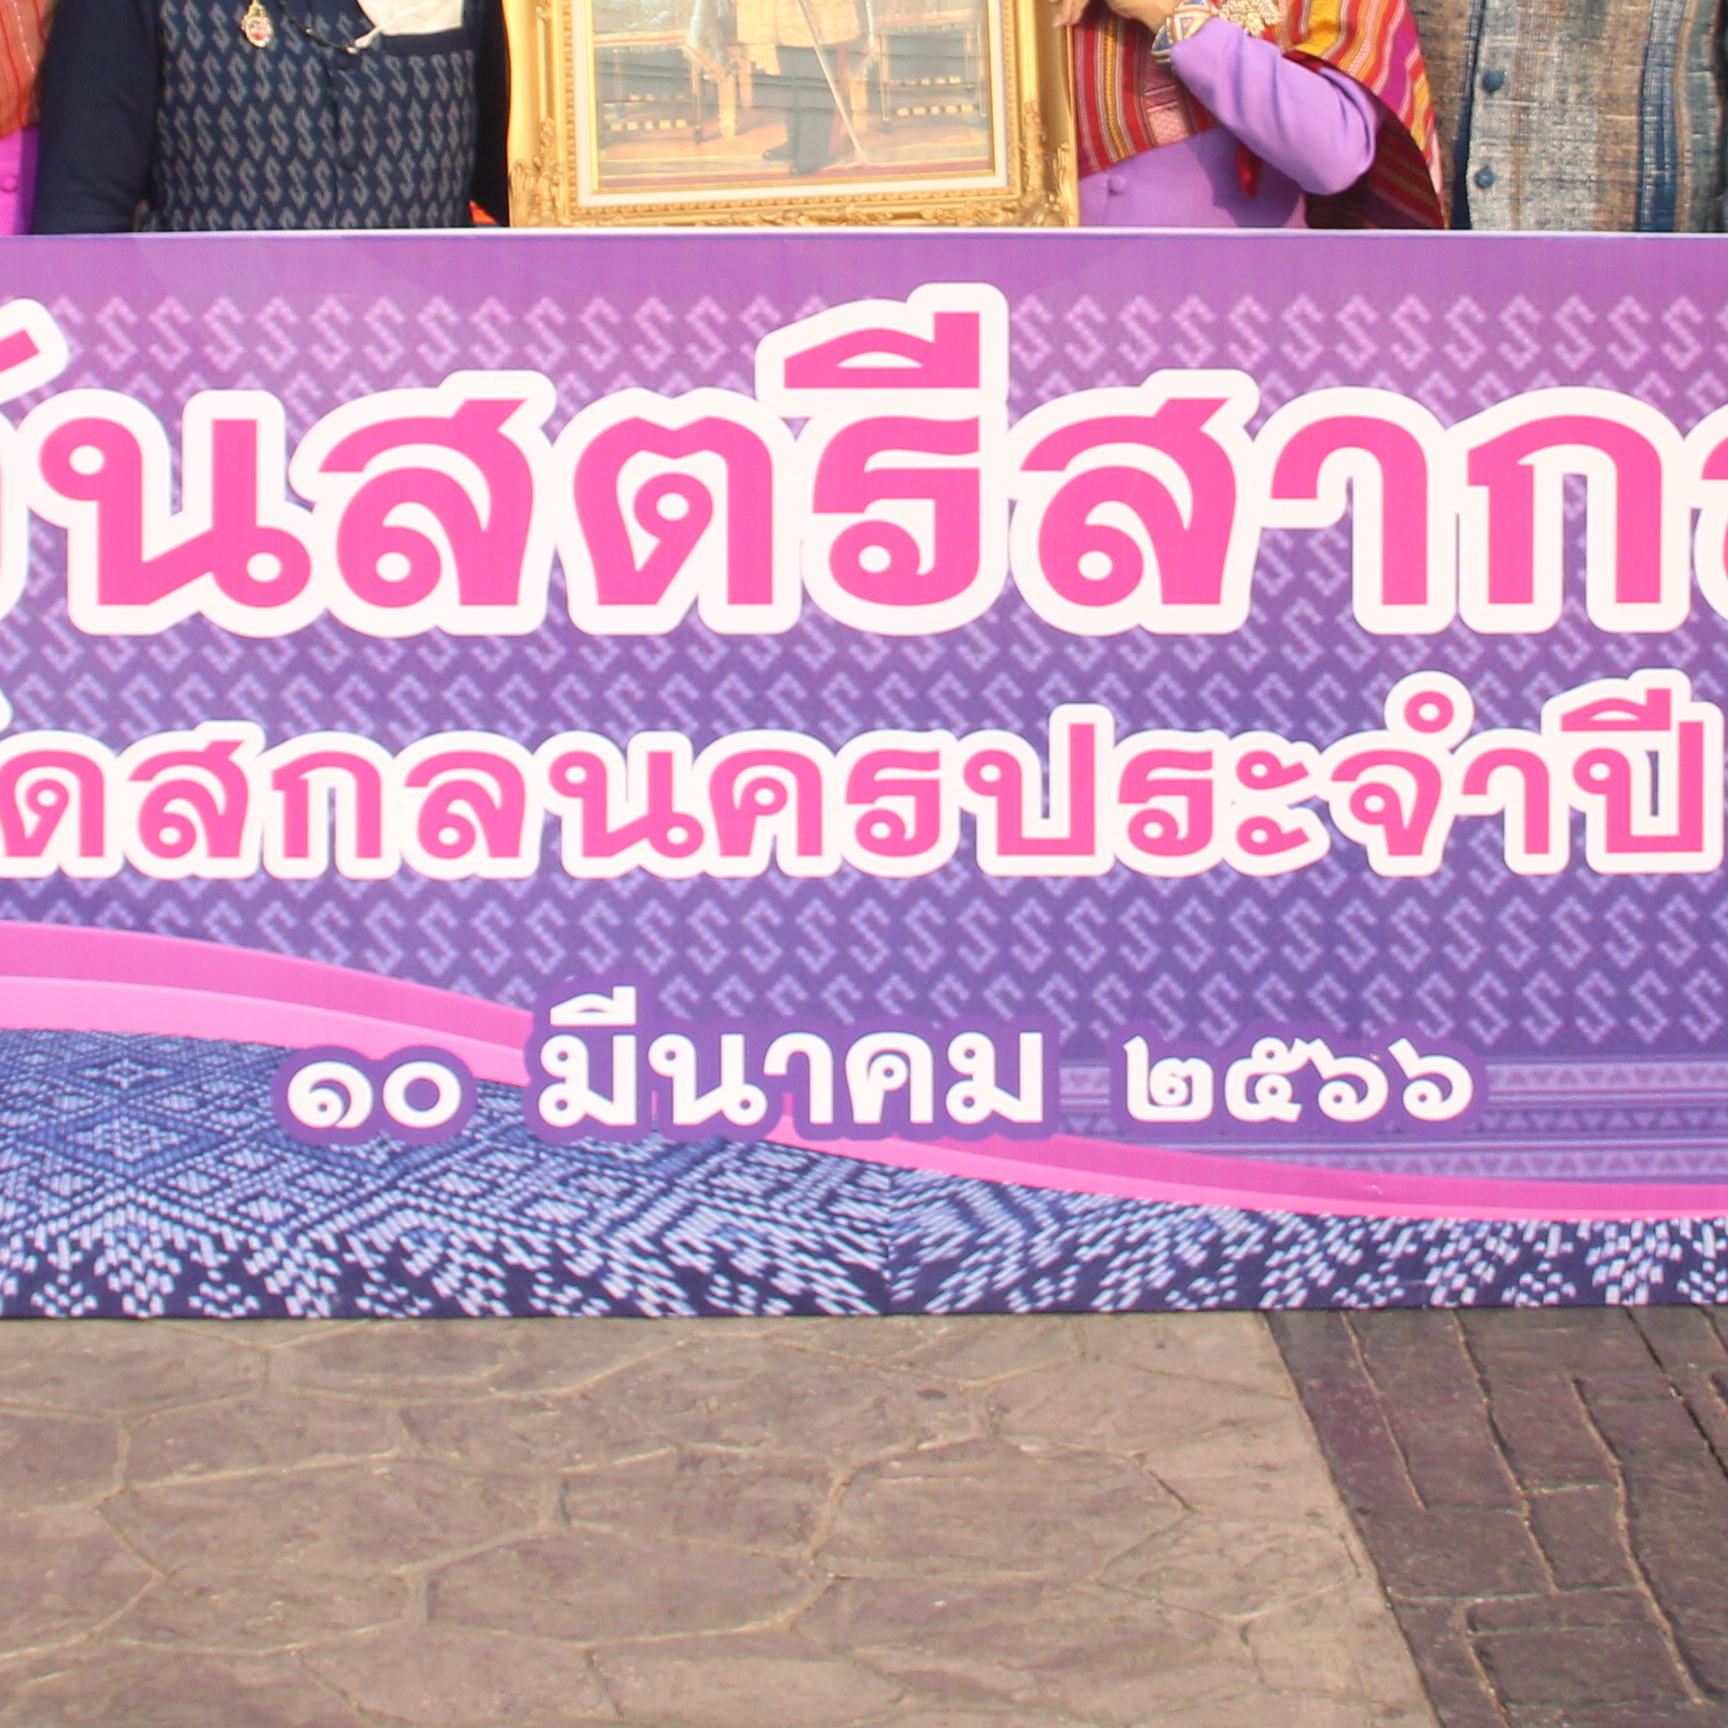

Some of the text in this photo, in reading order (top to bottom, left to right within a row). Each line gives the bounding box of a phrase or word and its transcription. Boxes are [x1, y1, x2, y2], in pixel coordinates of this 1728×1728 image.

[287, 985, 1473, 1128] ๑๐ มีนาคม ๒๕๖๖
